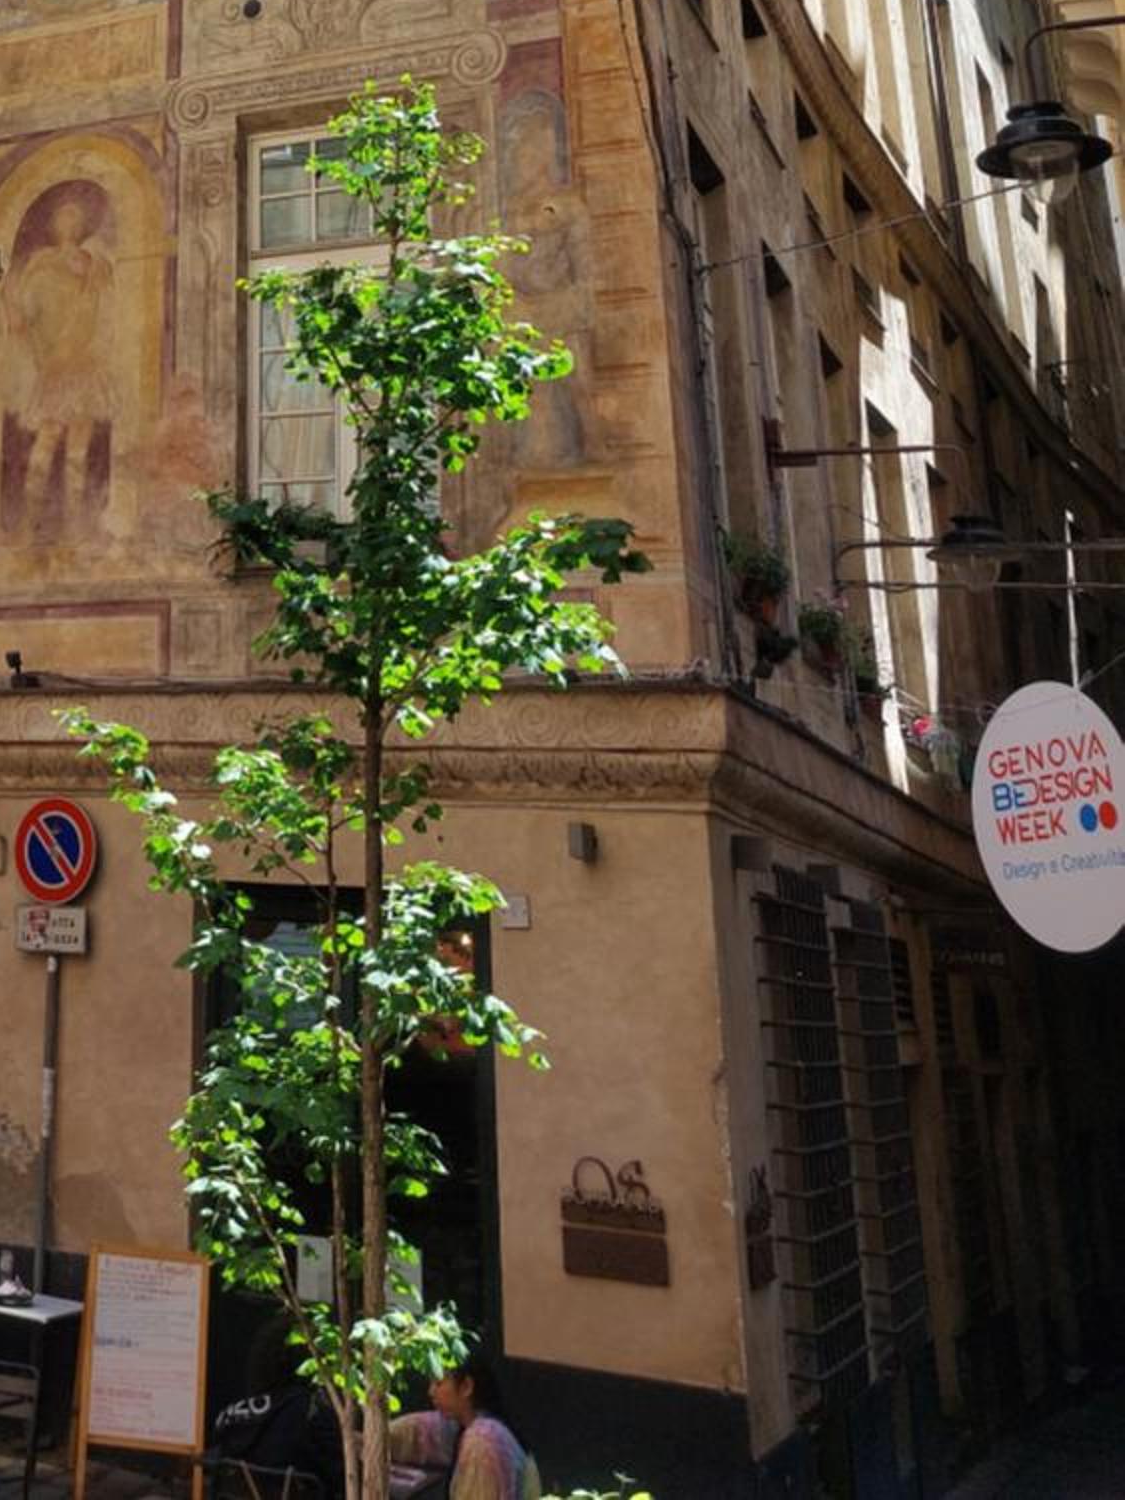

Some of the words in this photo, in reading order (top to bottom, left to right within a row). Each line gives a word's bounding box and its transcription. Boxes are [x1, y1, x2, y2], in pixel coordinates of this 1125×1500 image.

[987, 730, 1107, 779] GENOVA
[996, 808, 1067, 845] WEEK
[1002, 858, 1046, 881] Design
[1050, 859, 1058, 874] e
